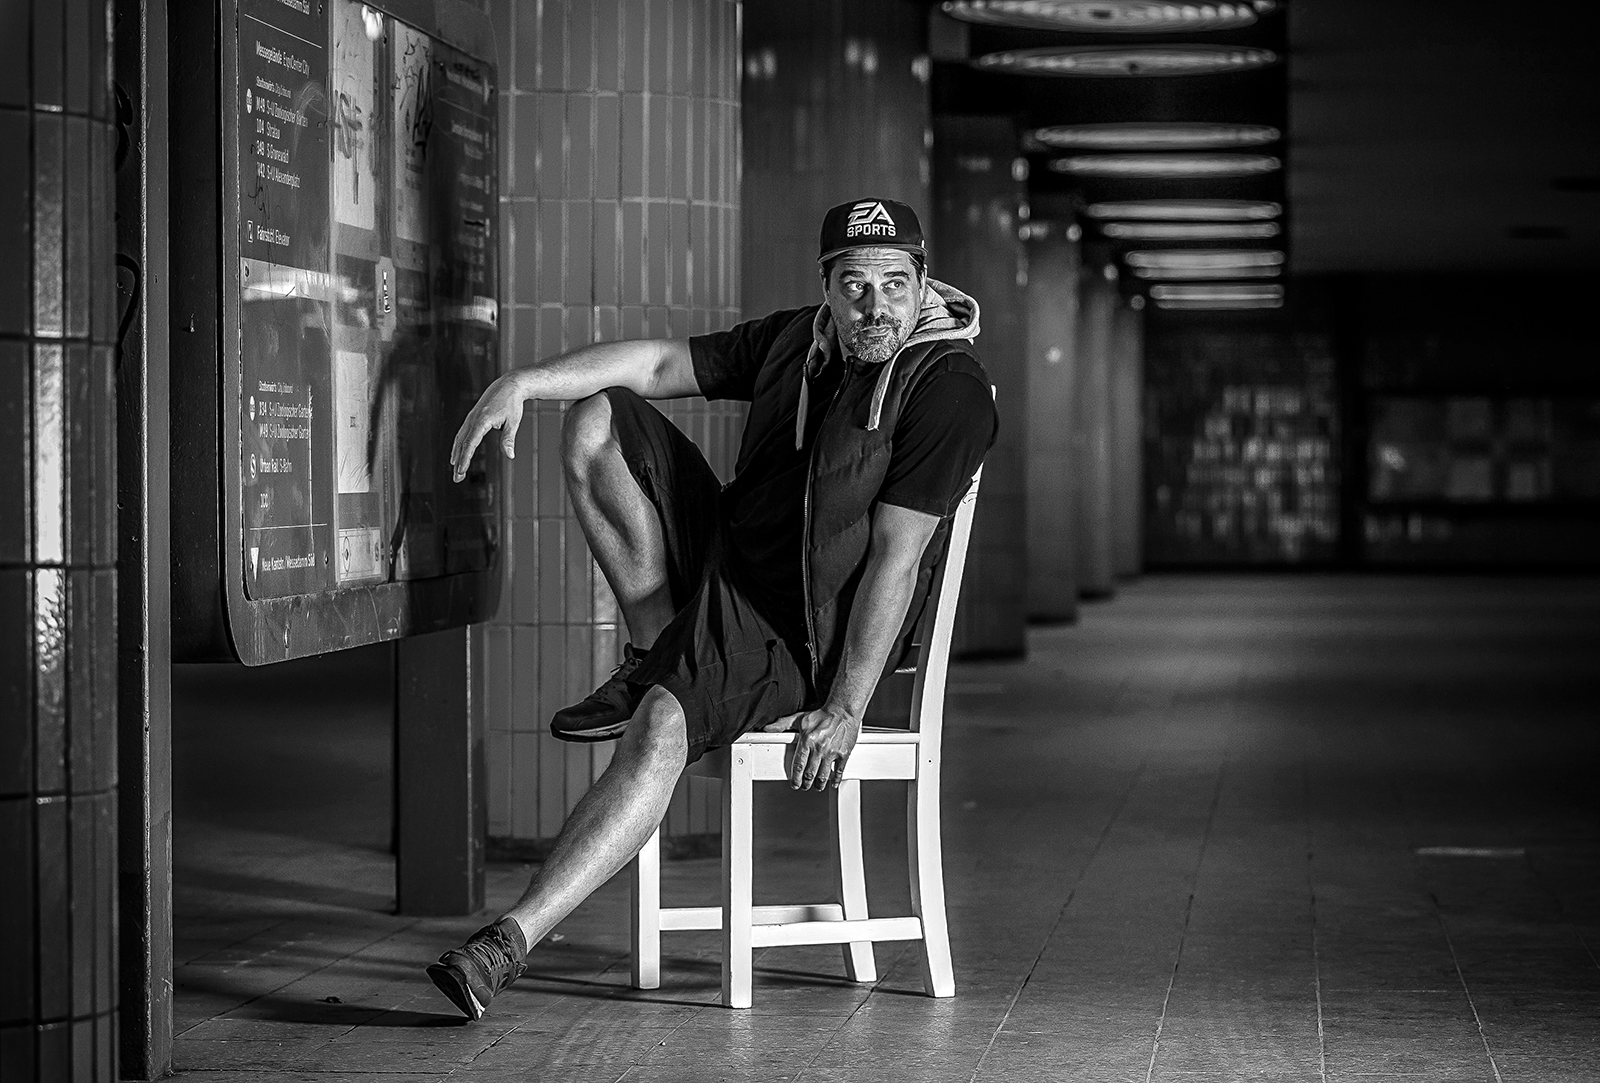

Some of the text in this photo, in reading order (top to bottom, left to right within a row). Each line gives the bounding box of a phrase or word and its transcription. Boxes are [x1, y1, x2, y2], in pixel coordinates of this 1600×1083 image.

[256, 40, 283, 65] Messegelände
[296, 110, 309, 128] Garten
[256, 140, 265, 156] 349
[275, 167, 301, 189] Alexanderplatz
[847, 202, 895, 226] EA
[275, 229, 291, 247] Elevator
[846, 223, 896, 238] SPORTS
[260, 457, 293, 473] Urban Rail S-Bahn
[261, 558, 272, 572] Neue
[308, 552, 316, 567] Süd
